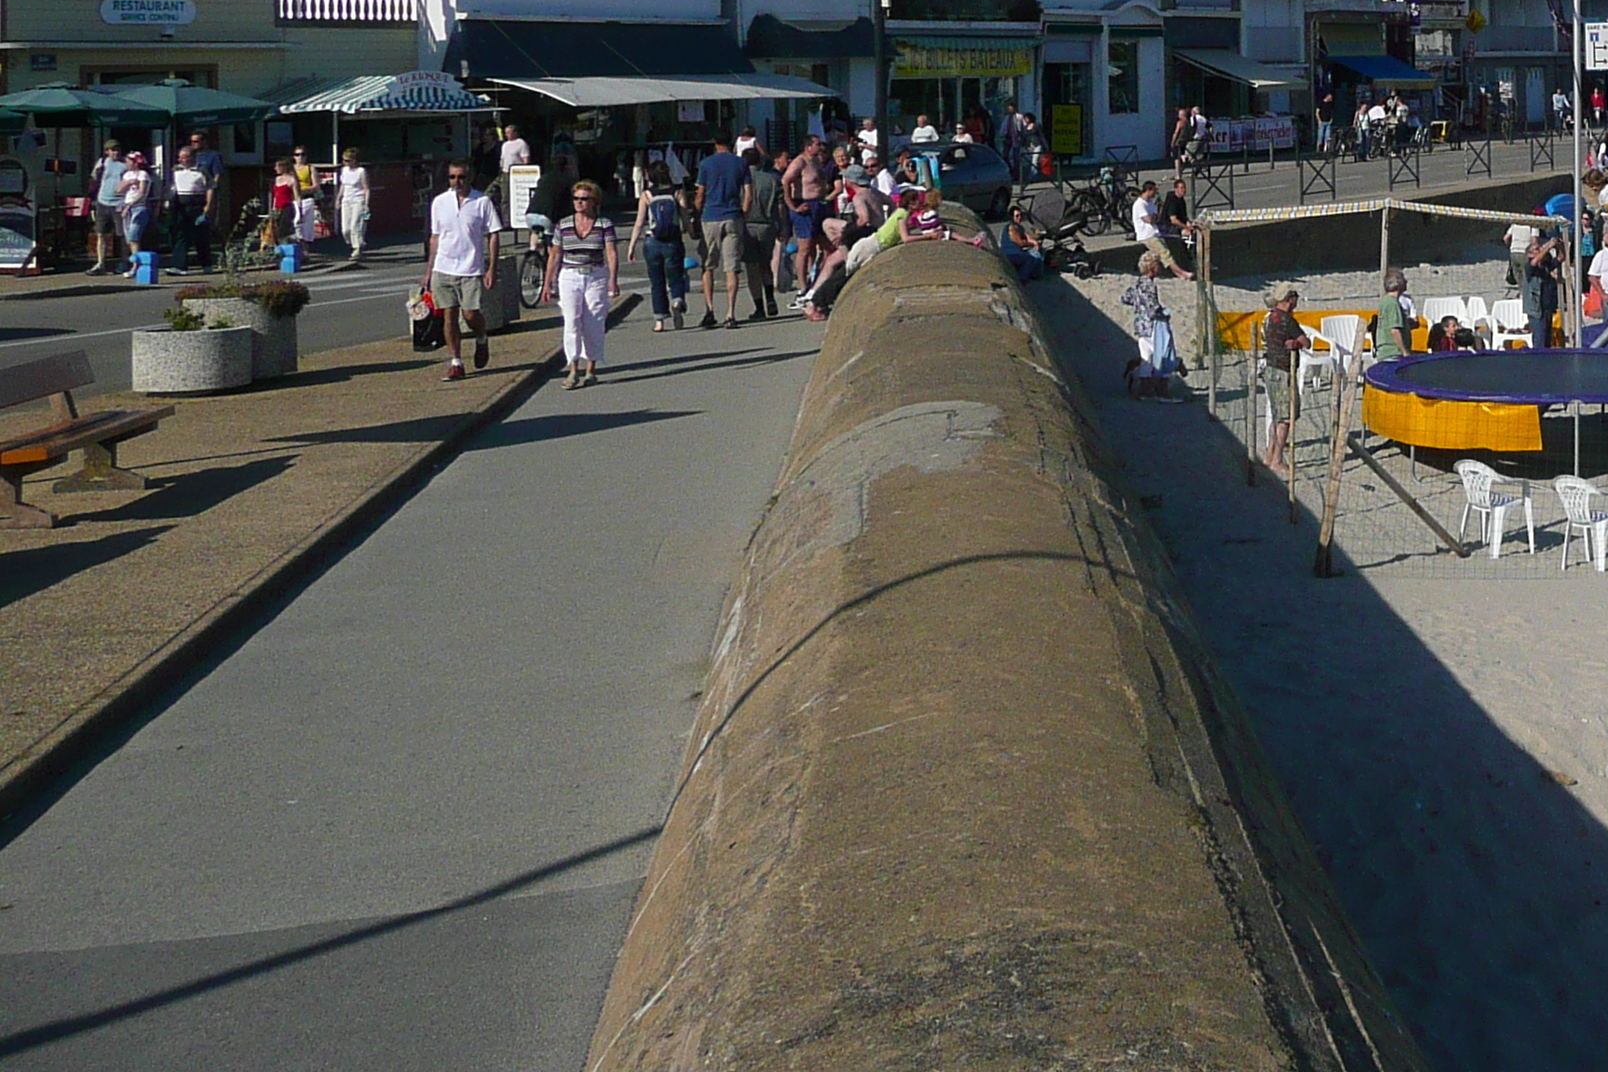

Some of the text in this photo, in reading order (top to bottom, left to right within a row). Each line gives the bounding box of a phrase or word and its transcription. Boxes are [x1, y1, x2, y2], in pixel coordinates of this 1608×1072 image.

[112, 0, 186, 12] RESTAURANT
[120, 13, 180, 22] SERVICE CONTINU
[925, 49, 966, 70] BILLETS
[970, 49, 1016, 70] BATEAUX
